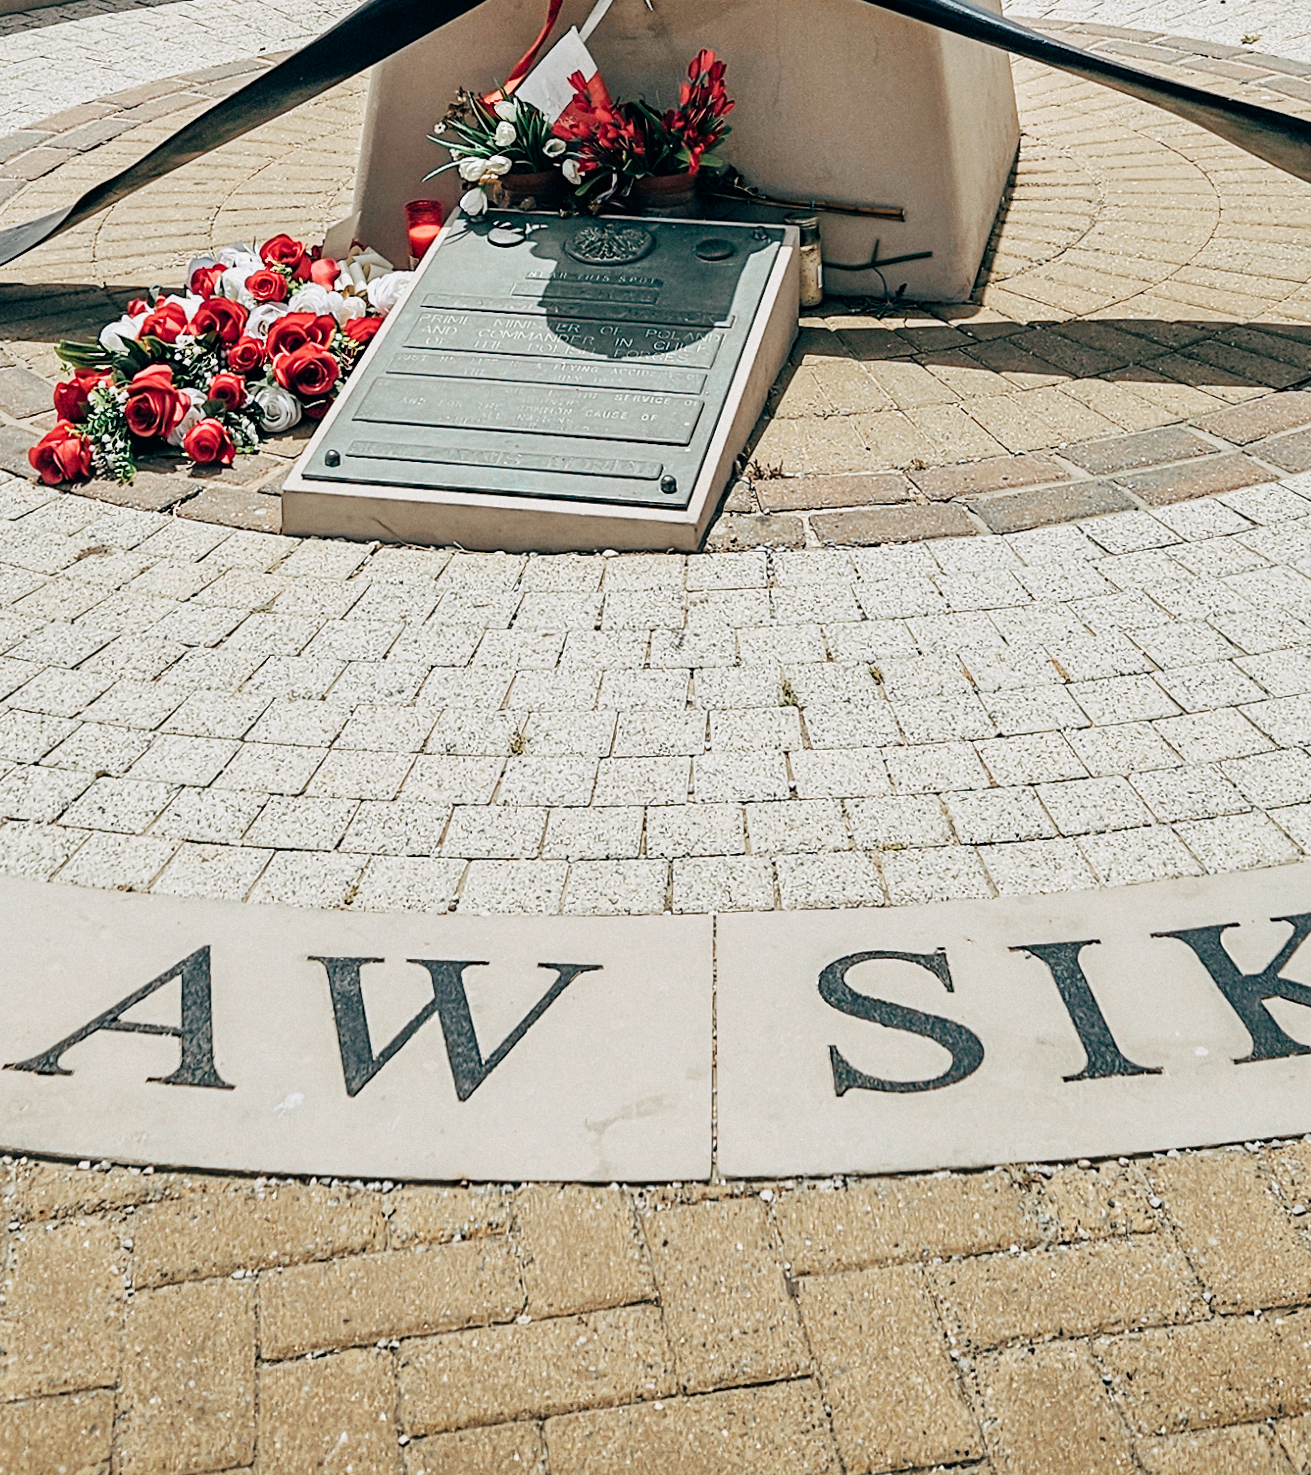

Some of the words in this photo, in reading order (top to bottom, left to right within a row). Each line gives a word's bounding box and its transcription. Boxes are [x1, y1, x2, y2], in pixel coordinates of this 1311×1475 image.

[422, 325, 458, 336] AND
[614, 337, 633, 347] IN
[645, 329, 722, 343] POLAND
[614, 394, 671, 406] SERVICE
